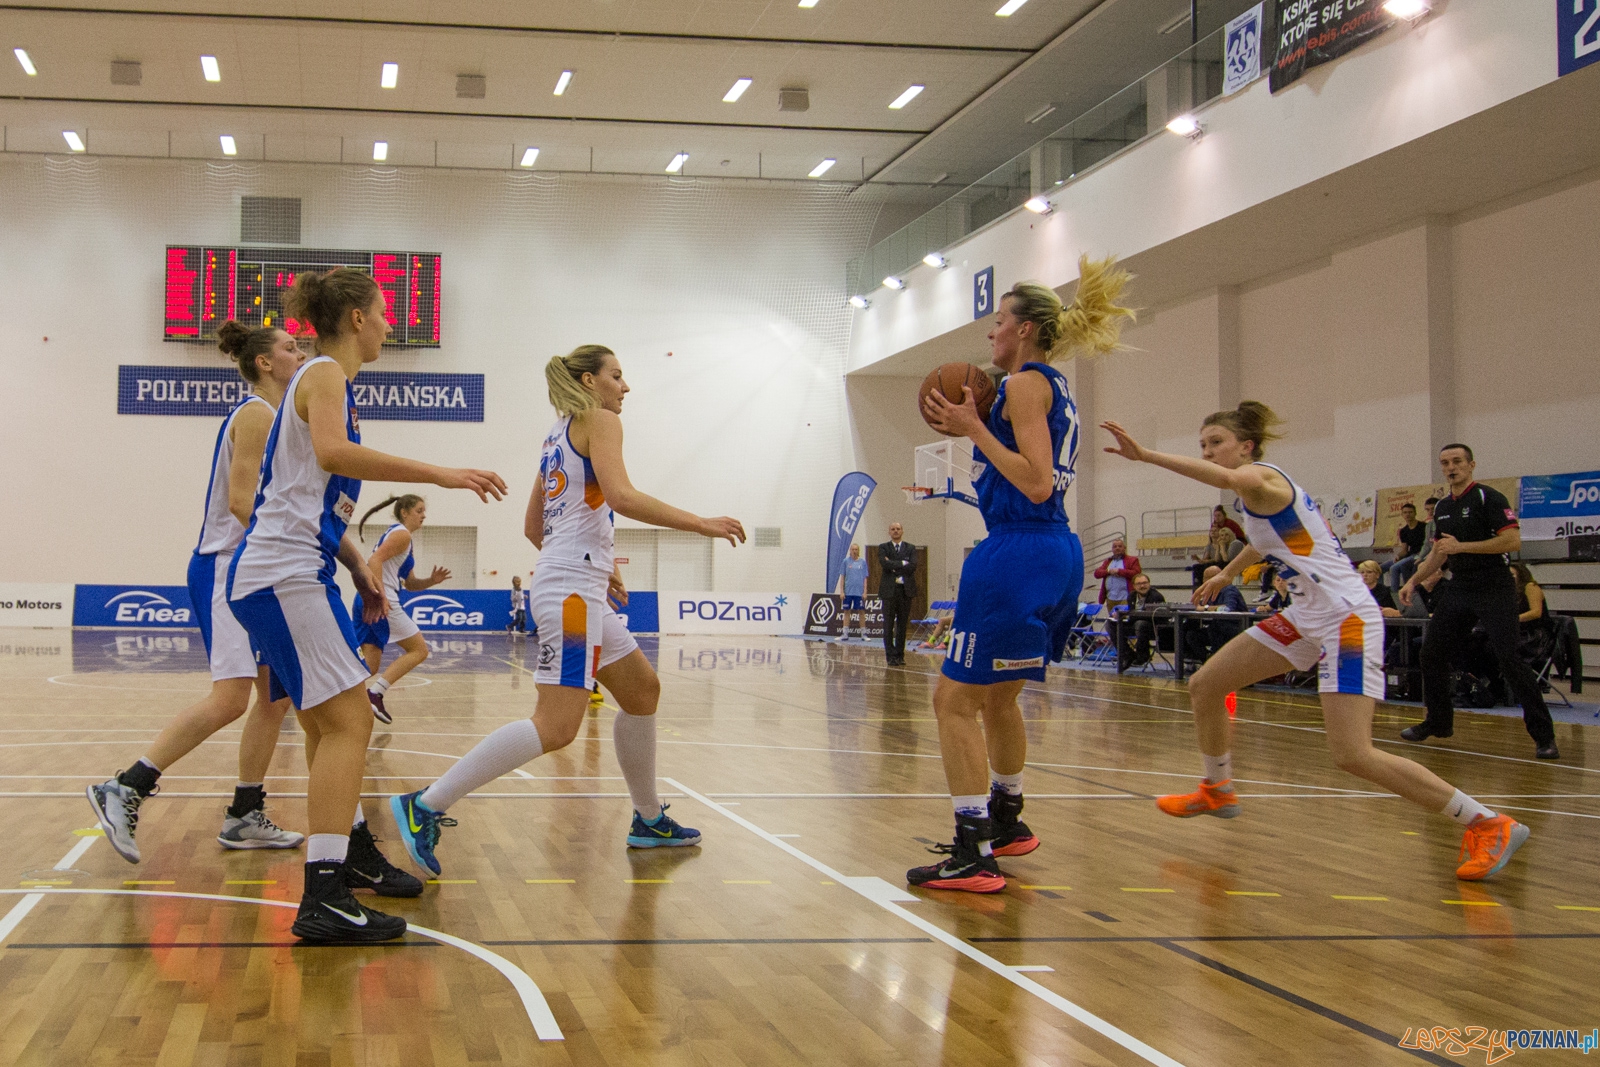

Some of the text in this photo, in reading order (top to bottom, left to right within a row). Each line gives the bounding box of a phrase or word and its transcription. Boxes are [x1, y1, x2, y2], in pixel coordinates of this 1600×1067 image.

[1321, 2, 1343, 24] SIĘ
[977, 273, 988, 312] 3
[136, 379, 467, 408] POLITECH ZNAŃSKA
[1550, 478, 1600, 509] Spo
[841, 484, 870, 535] Enea
[16, 600, 62, 610] Motors
[115, 602, 191, 622] Enea
[411, 606, 484, 626] Enea
[947, 628, 966, 663] 11
